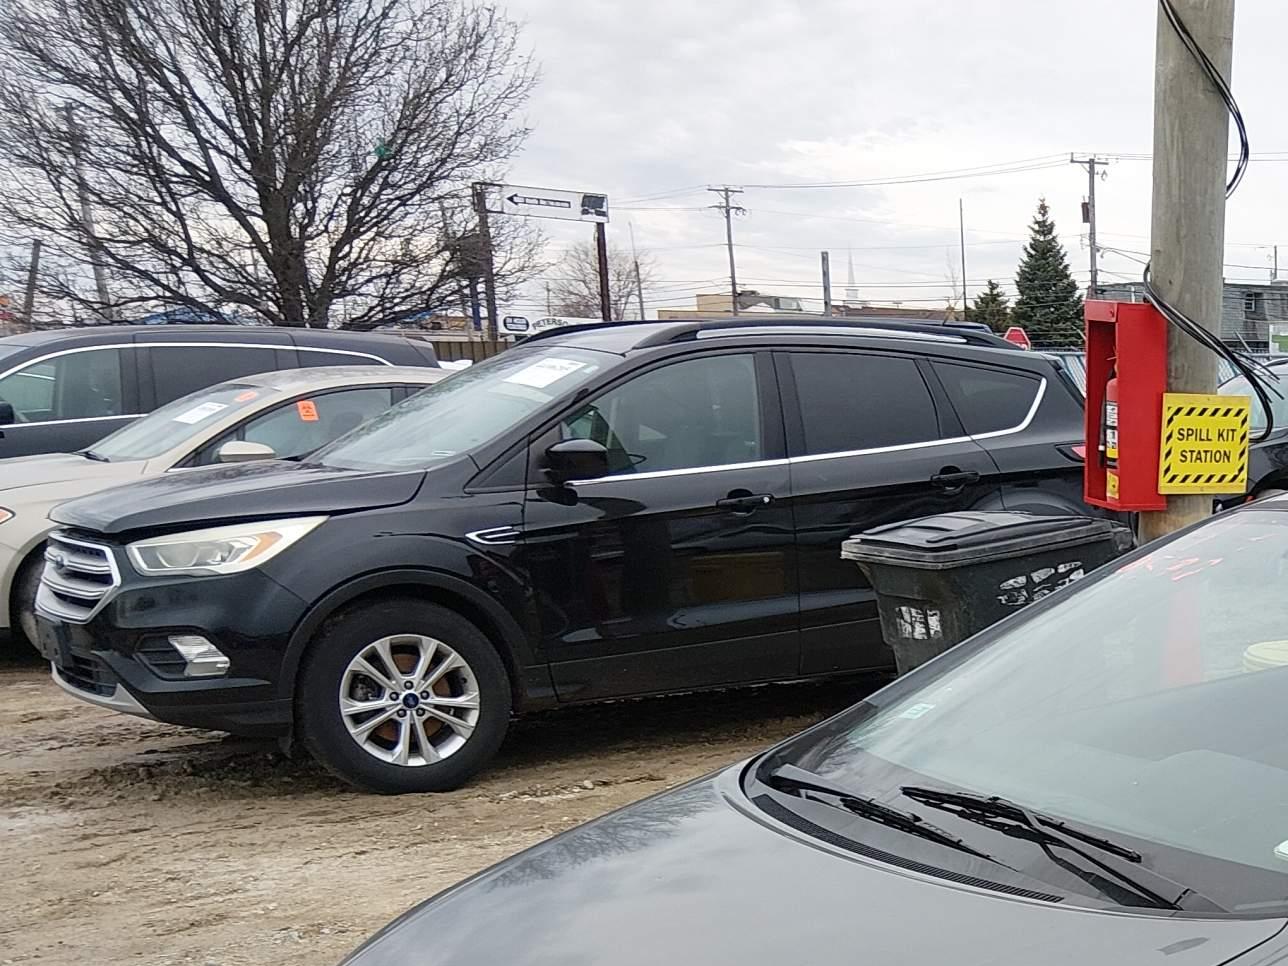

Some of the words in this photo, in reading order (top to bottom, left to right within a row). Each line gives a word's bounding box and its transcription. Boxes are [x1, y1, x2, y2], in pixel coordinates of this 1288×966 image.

[1177, 428, 1212, 442] SPILL
[1217, 428, 1237, 442] KIT
[1179, 449, 1231, 464] STATION
